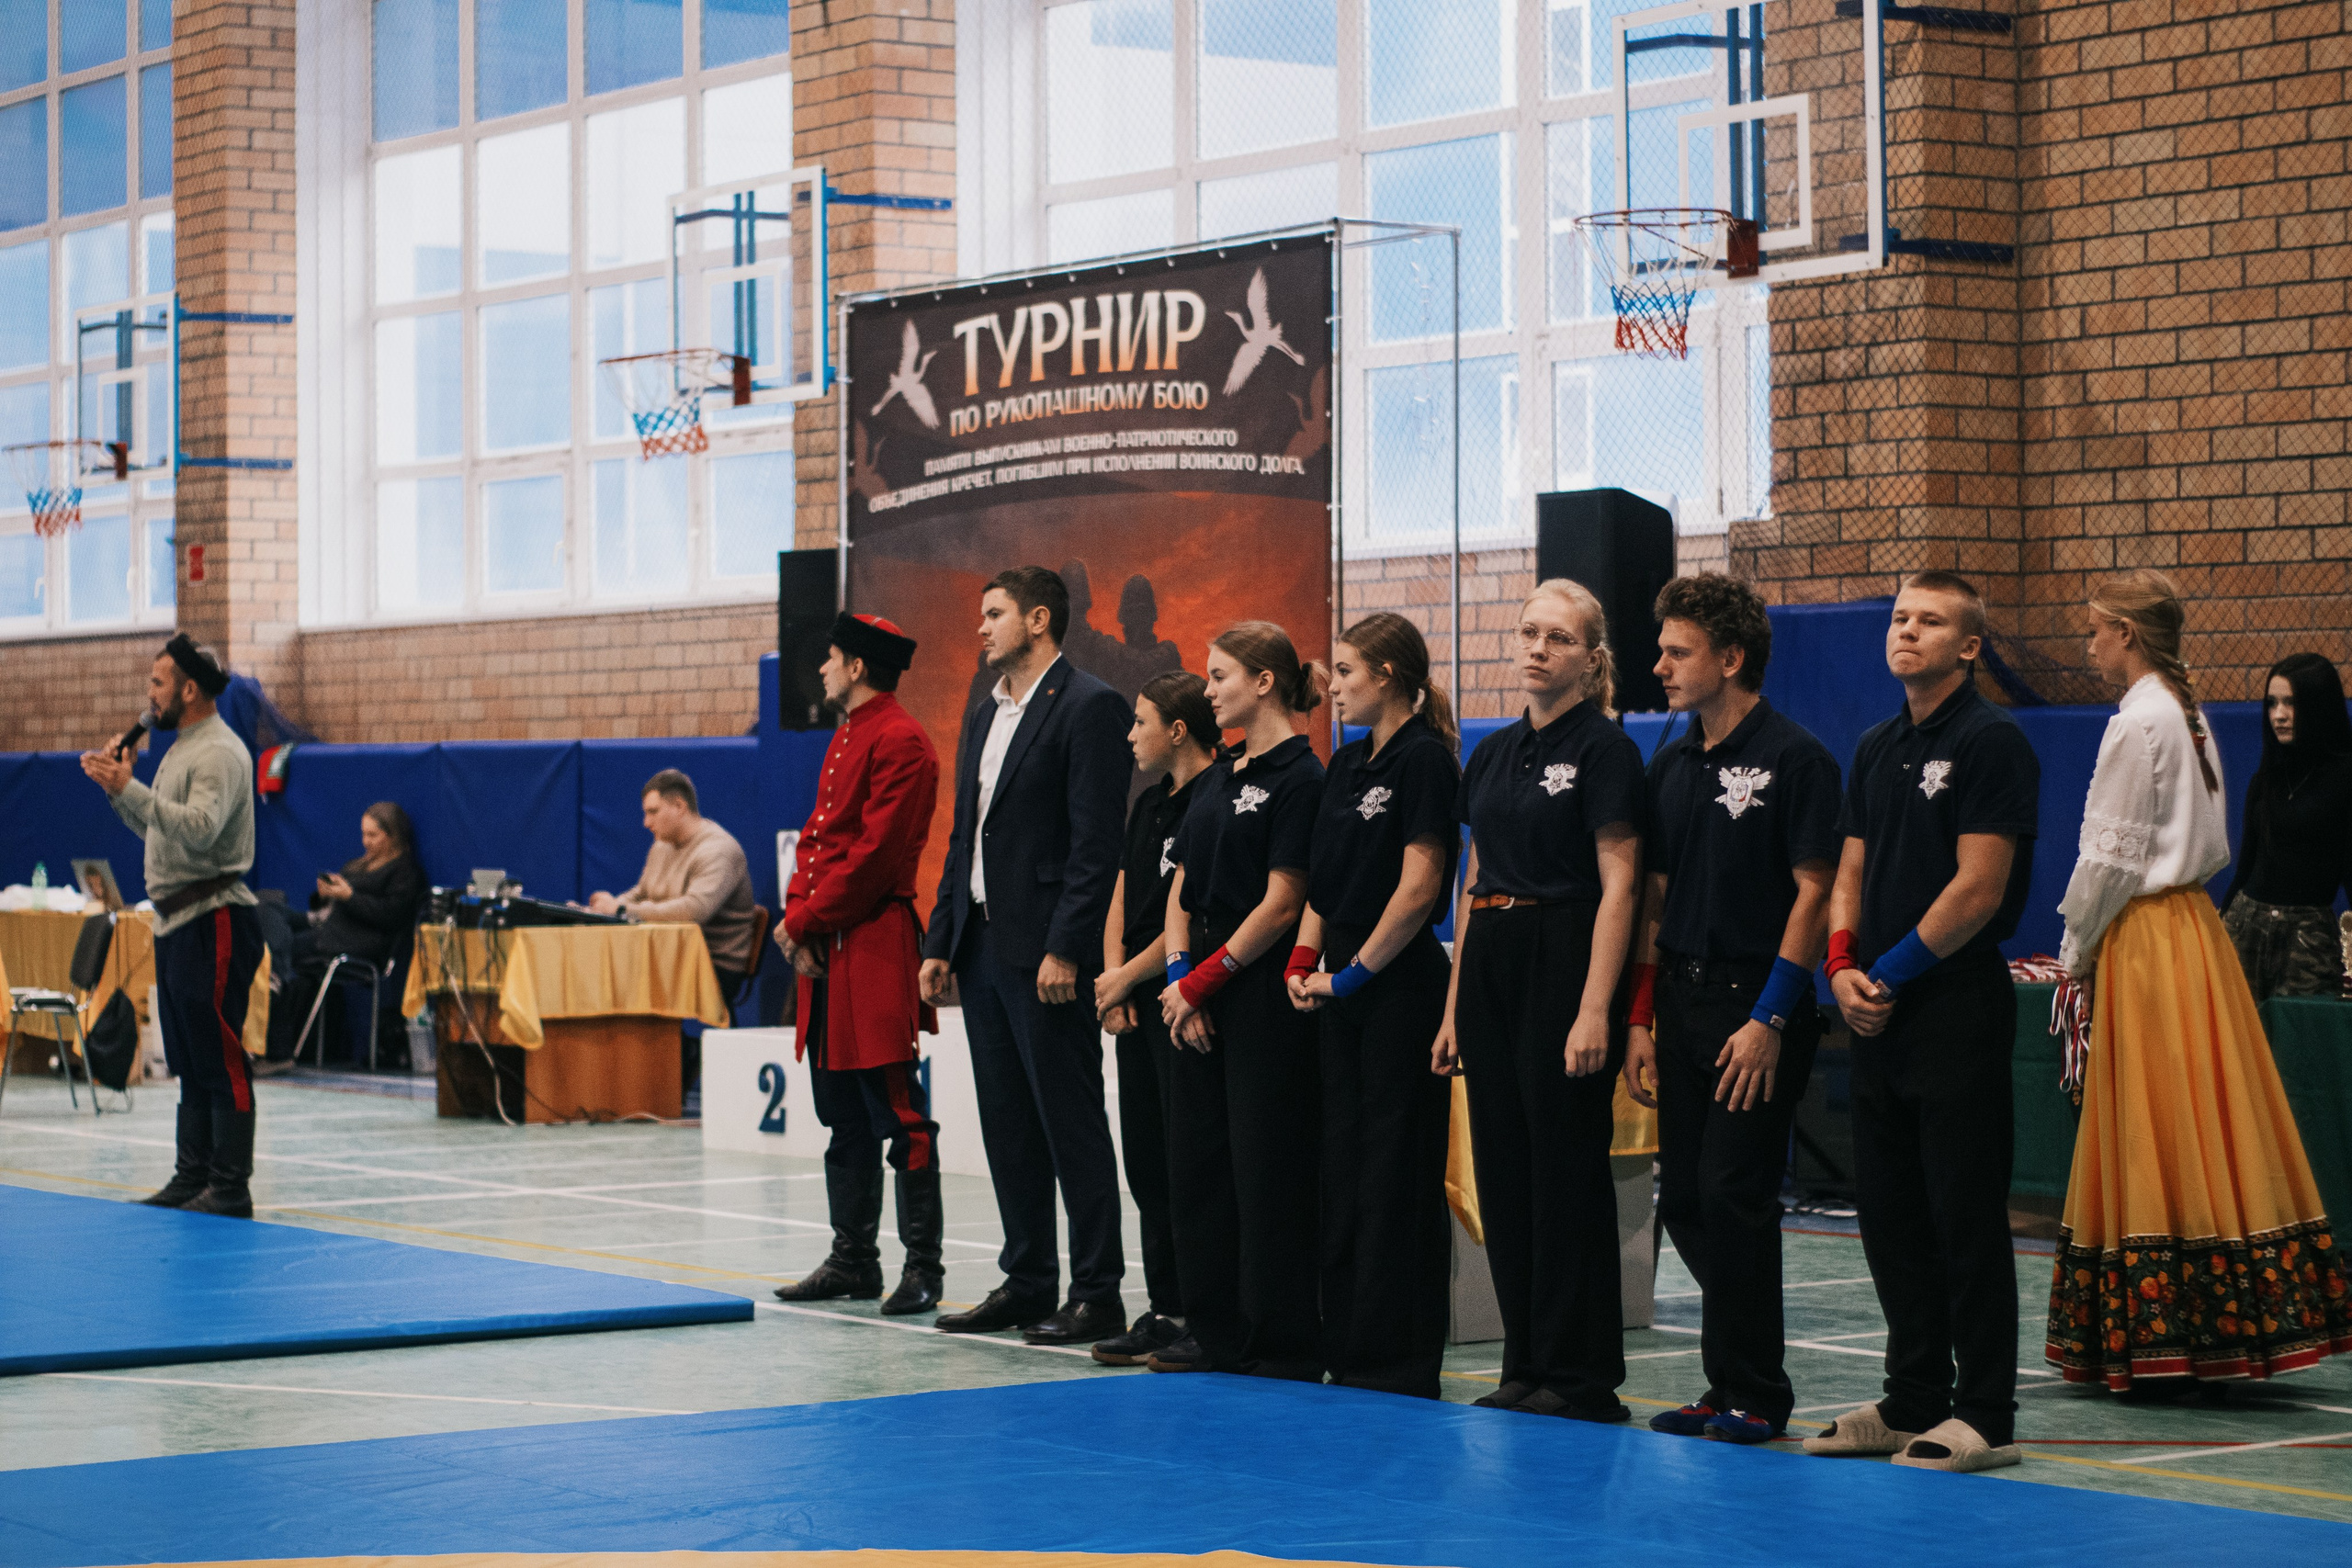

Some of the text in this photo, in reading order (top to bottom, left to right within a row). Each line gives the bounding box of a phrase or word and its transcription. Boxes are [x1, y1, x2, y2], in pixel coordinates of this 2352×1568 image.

[954, 290, 1206, 397] ТУРНИР
[950, 380, 1208, 437] ПО РУКОПАШНОМУ БОЮ
[923, 451, 972, 477] ПАМЯТИ
[995, 459, 1065, 485] ПОГИБШИМ
[1066, 456, 1092, 475] ПРИ
[1179, 452, 1257, 472] ВОИНСКОГО
[758, 1061, 786, 1134] 2
